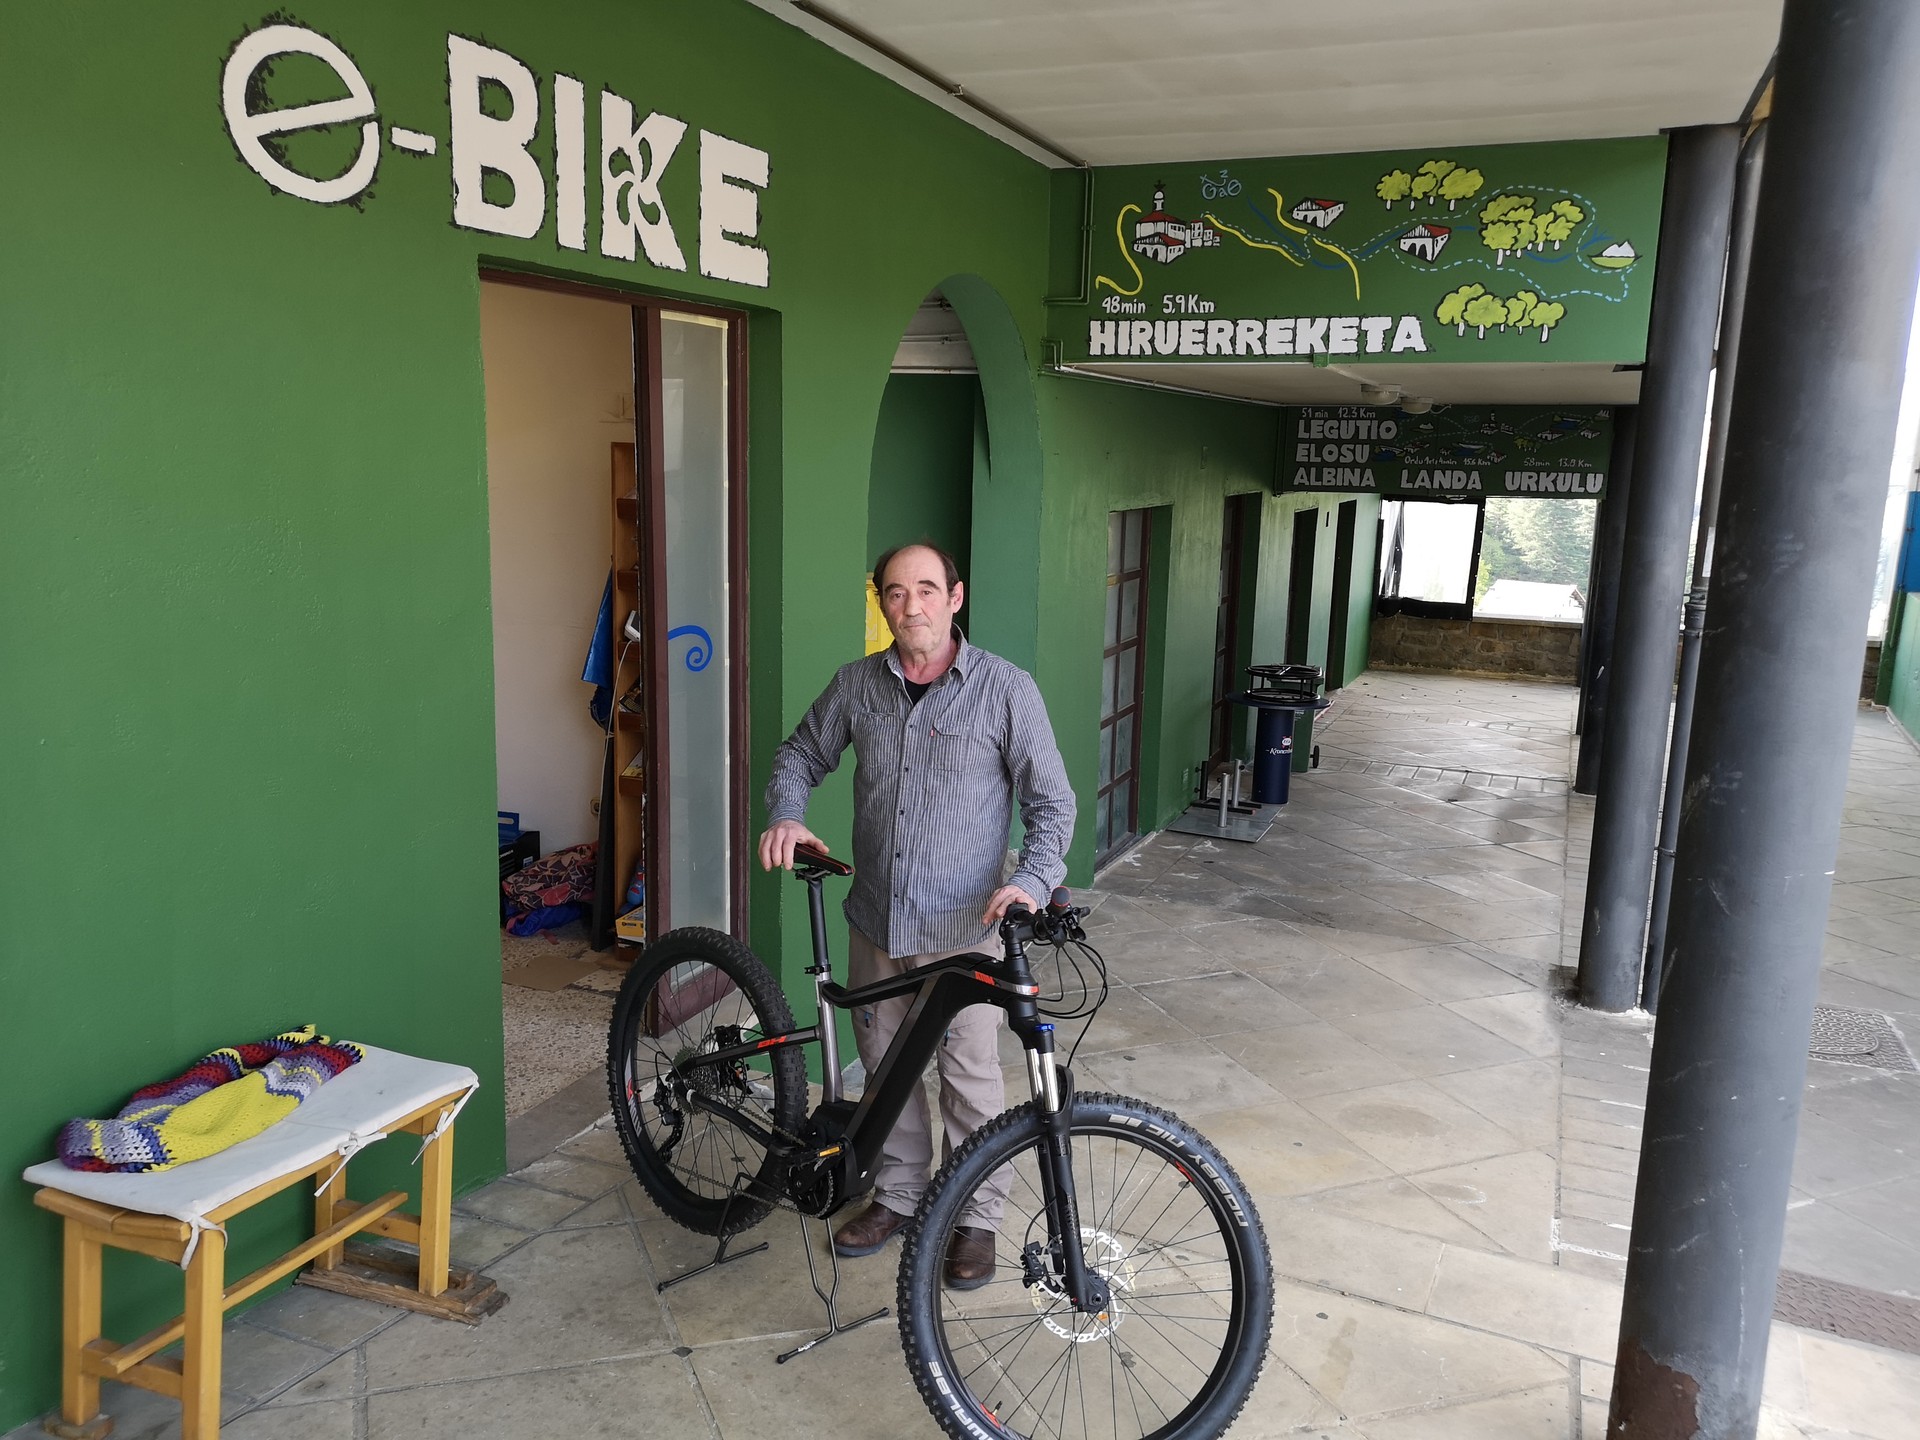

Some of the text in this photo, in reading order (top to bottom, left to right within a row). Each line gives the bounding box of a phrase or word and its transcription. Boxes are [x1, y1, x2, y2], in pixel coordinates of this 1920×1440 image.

[1088, 315, 1428, 357] HIRUERREKETA
[1359, 407, 1376, 419] Km
[1297, 419, 1398, 440] LEGUTIO
[1295, 443, 1370, 464] ELOSU
[1577, 458, 1592, 468] Km
[1293, 467, 1377, 488] ALBINA
[1400, 469, 1482, 490] LANDA
[1504, 471, 1604, 494] URKULU
[1145, 1123, 1249, 1227] NOBBY NIC
